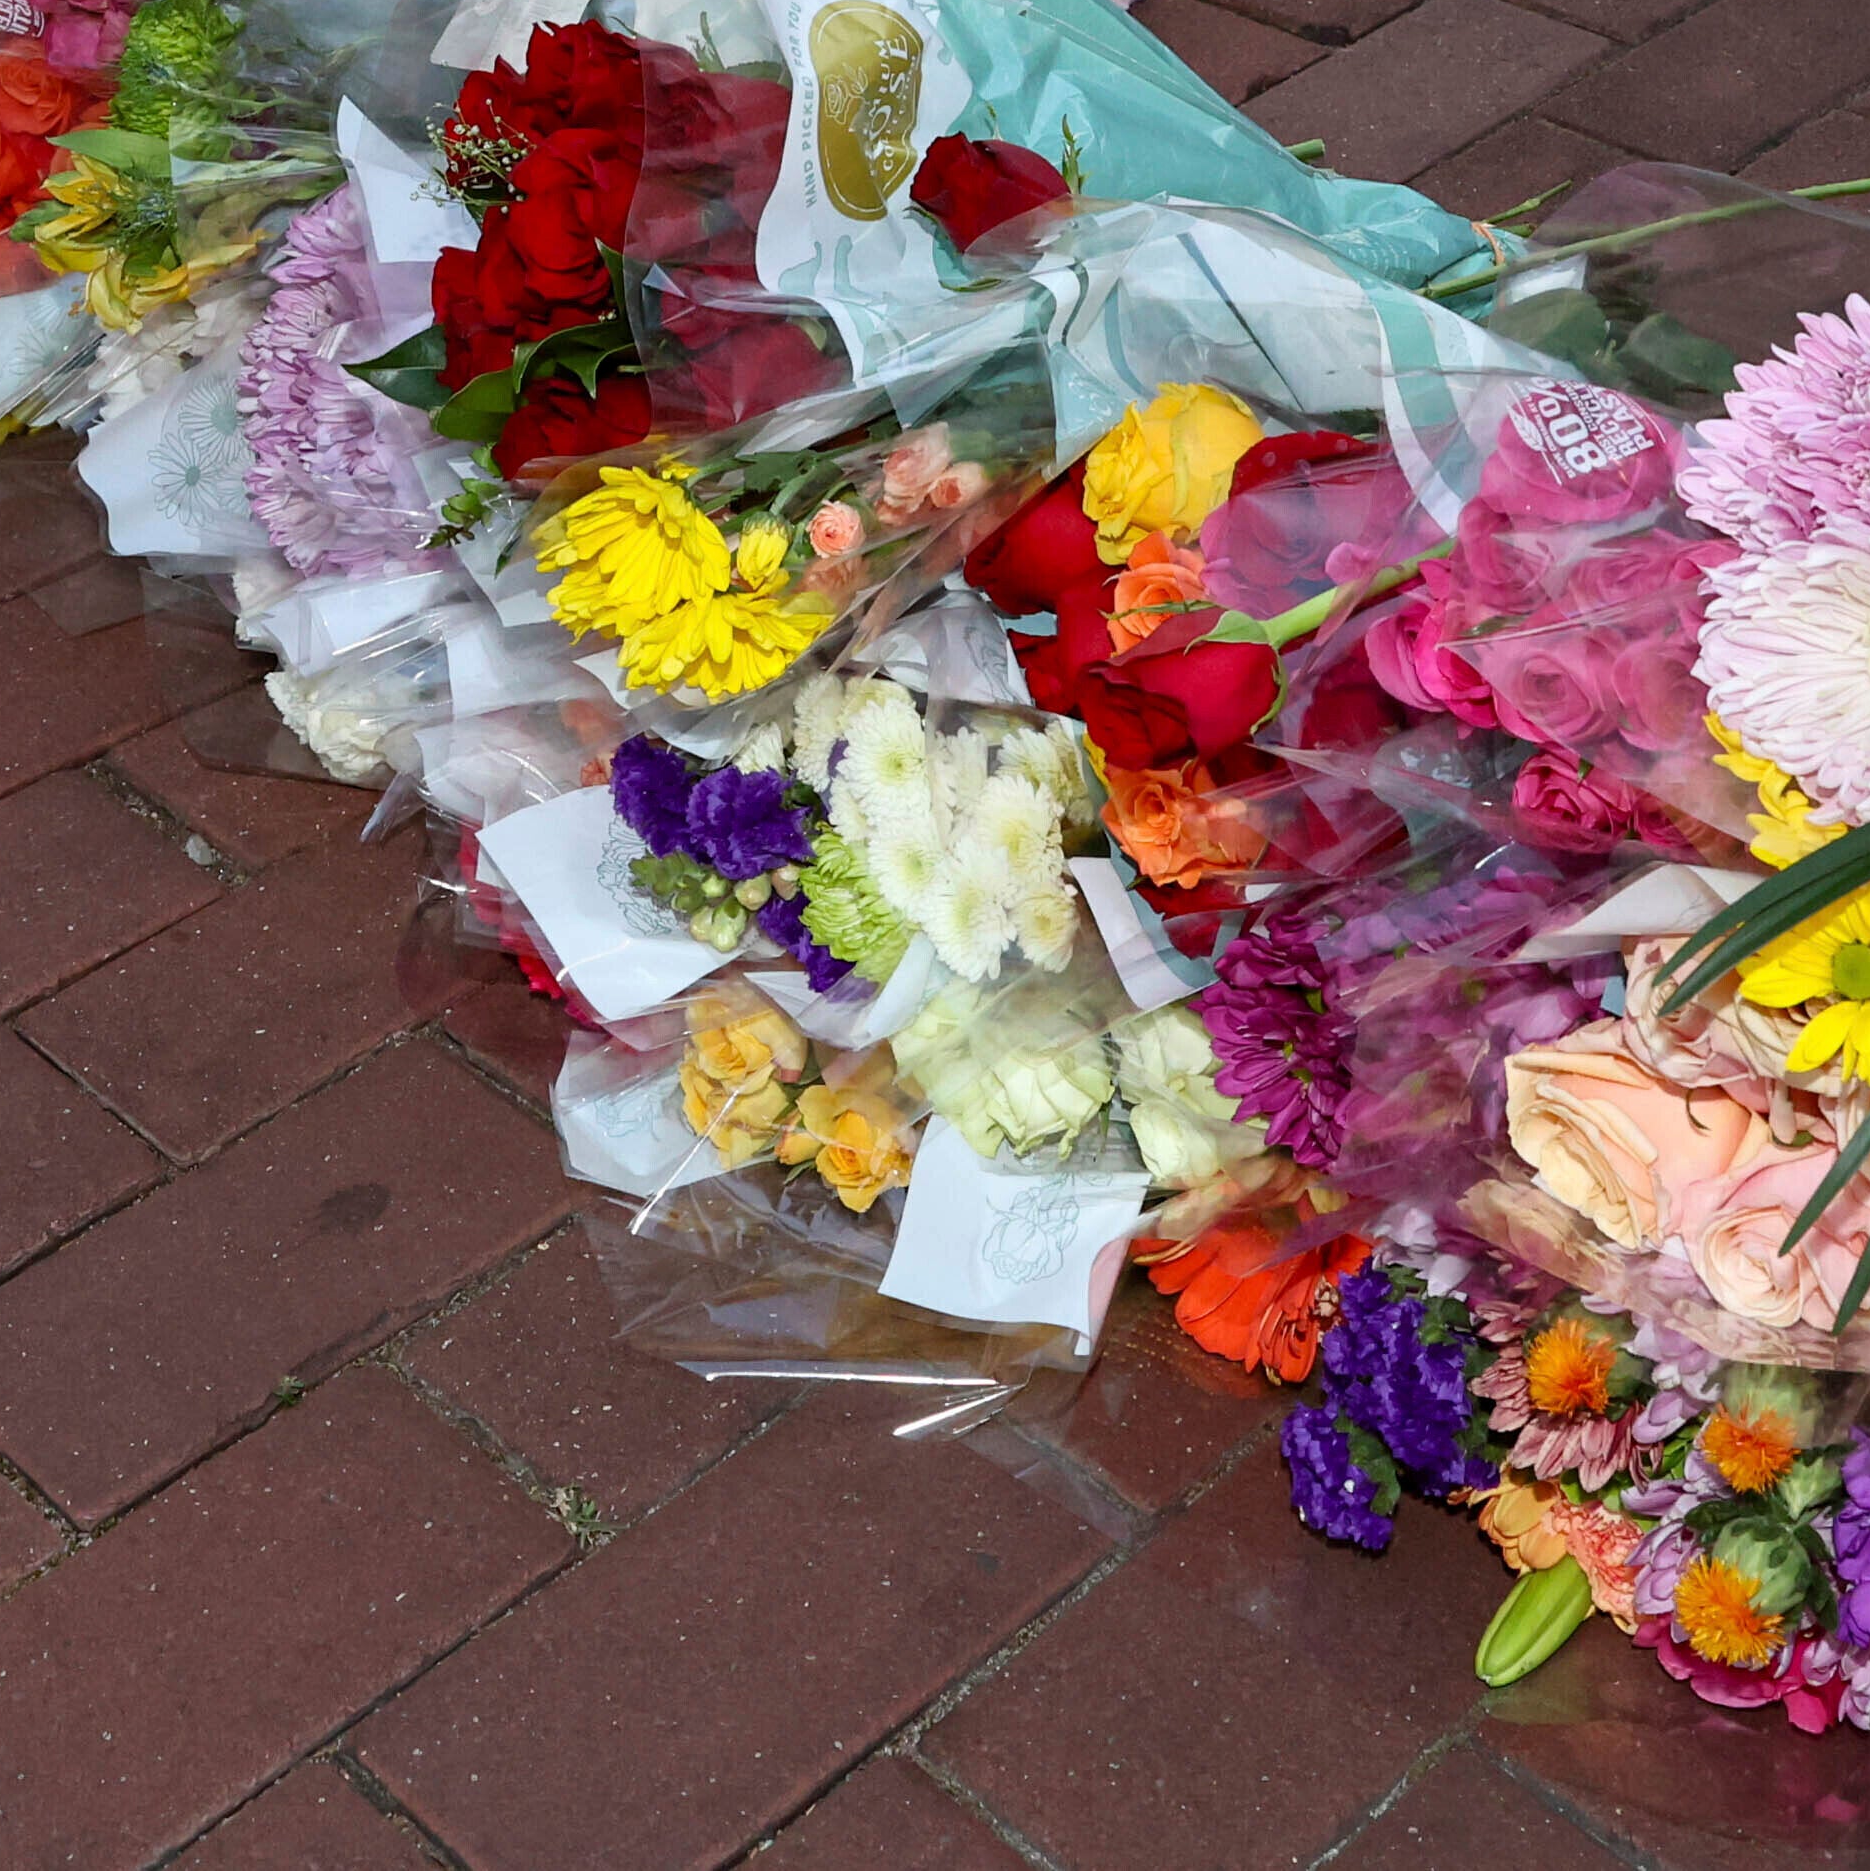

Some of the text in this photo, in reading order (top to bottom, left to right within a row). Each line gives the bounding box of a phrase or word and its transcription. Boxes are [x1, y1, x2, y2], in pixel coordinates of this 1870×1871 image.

[788, 1, 818, 209] HAND PICKED FOR YOU
[1525, 375, 1608, 474] 80%
[1560, 377, 1623, 461] POST CONSUM
[1570, 380, 1638, 457] RECYCLE
[1589, 385, 1655, 450] PLAST
